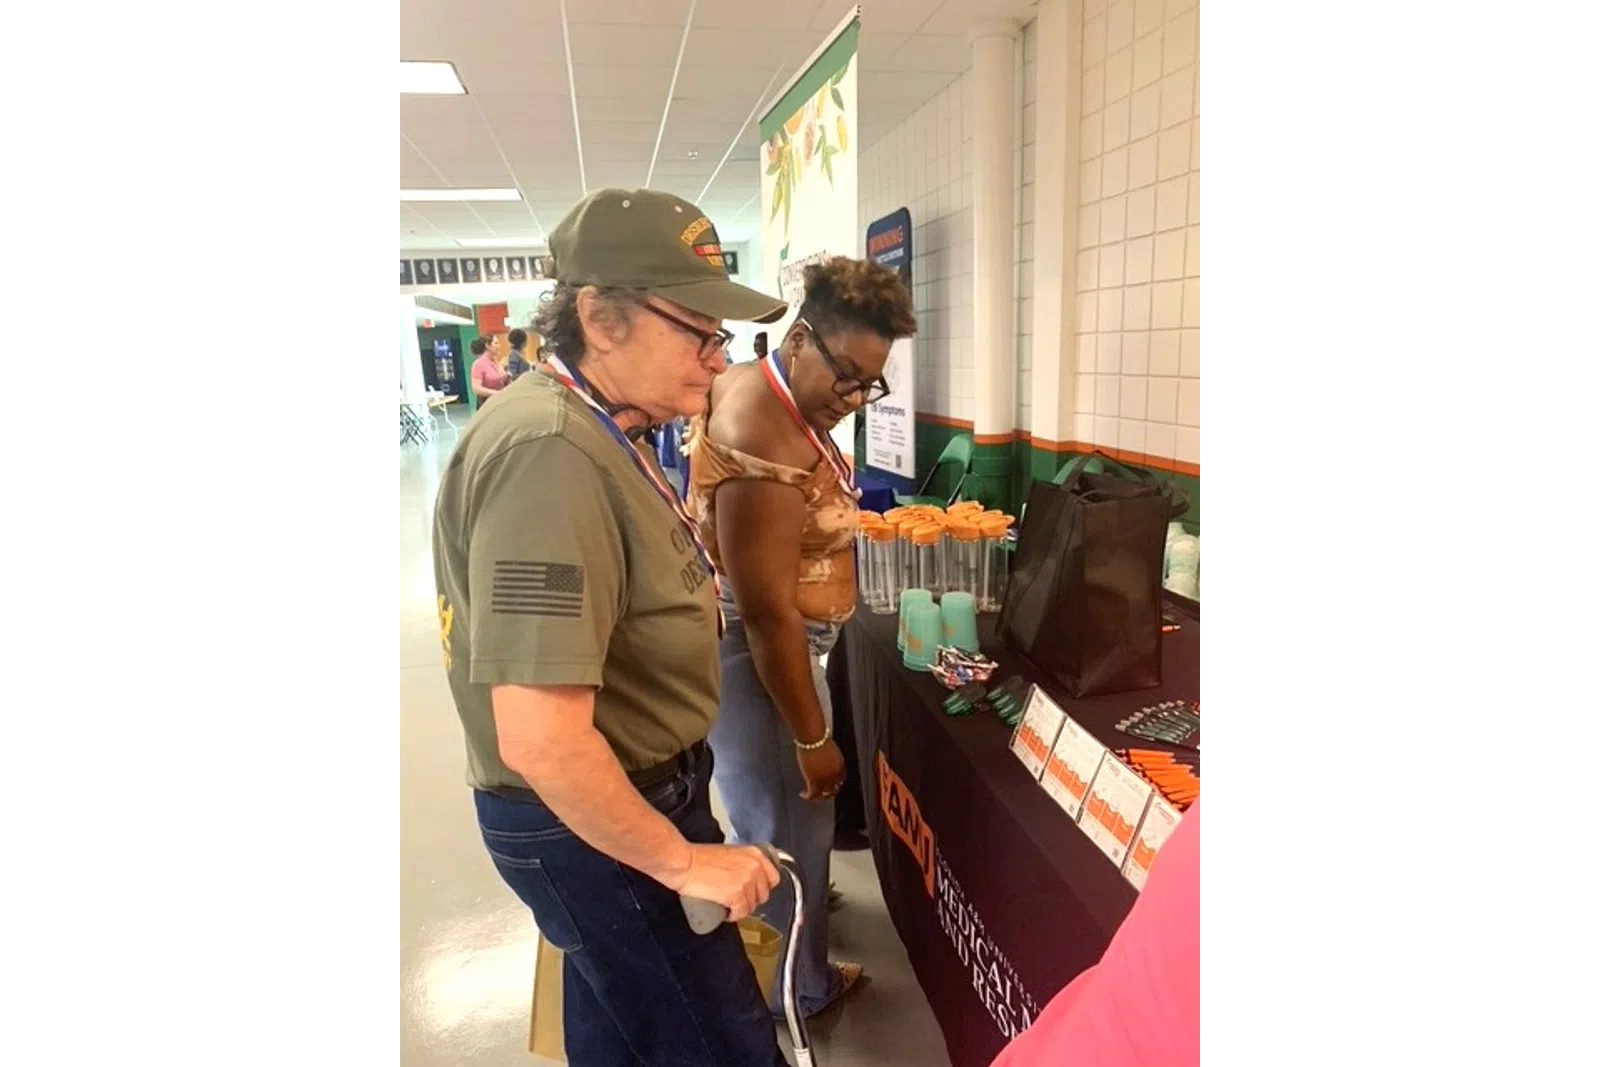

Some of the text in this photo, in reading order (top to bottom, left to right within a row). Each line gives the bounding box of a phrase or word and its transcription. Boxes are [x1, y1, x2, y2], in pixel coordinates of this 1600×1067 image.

[879, 403, 906, 417] Symptoms
[935, 863, 1017, 1016] MEDICAL
[937, 897, 969, 967] AND
[986, 935, 1041, 1014] UNIVERSI
